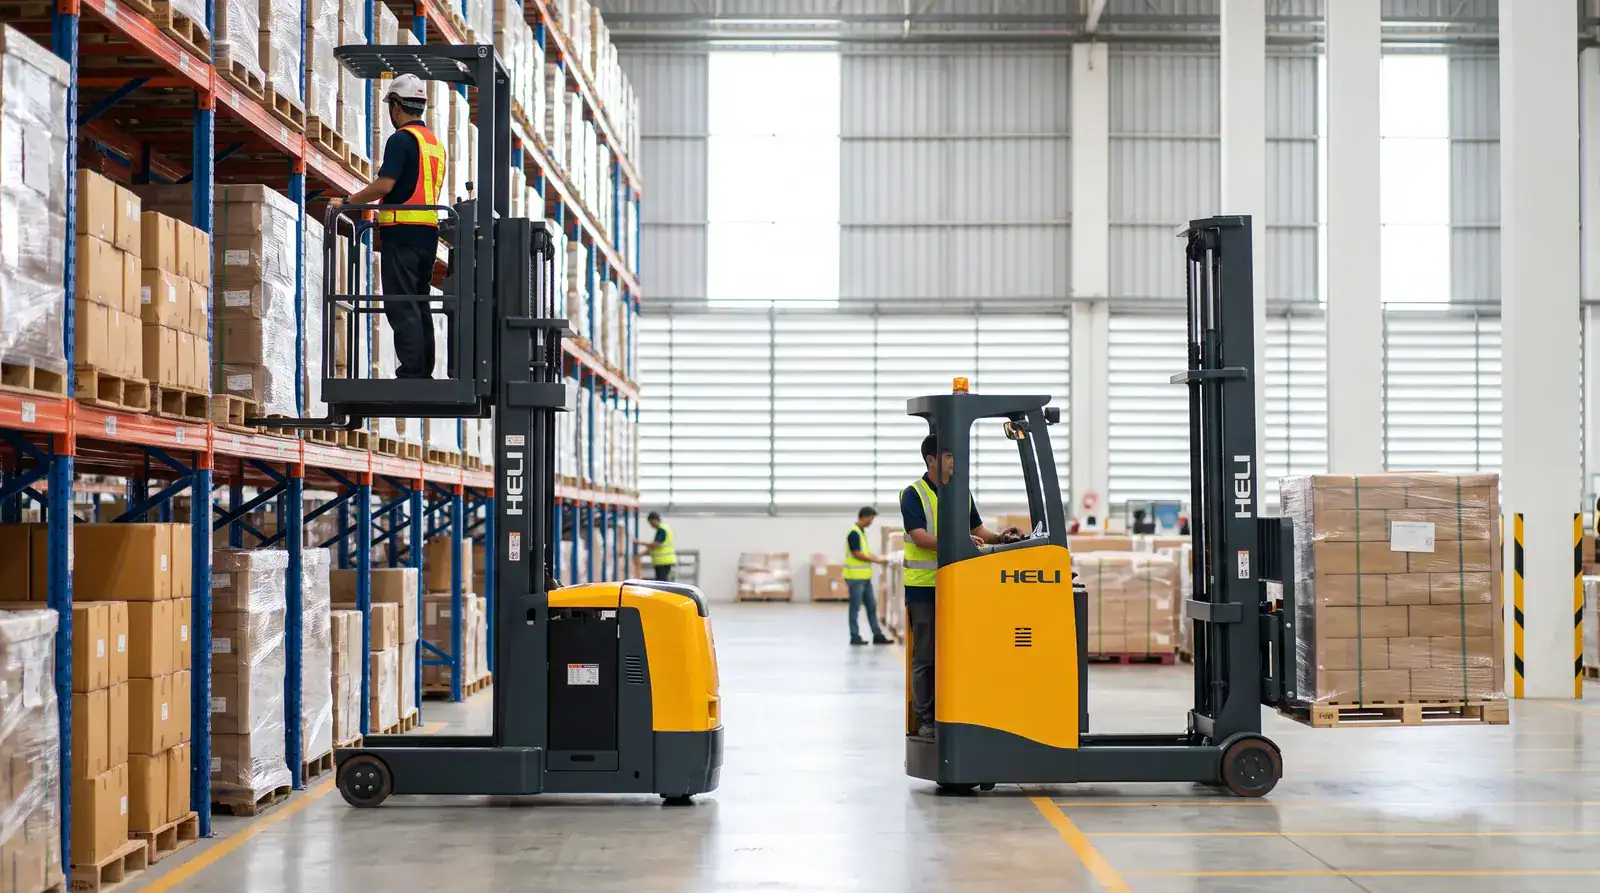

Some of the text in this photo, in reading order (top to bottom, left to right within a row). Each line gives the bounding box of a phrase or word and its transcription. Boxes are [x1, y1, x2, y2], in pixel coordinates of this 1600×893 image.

[506, 451, 523, 515] HELI
[1234, 455, 1252, 518] HELI
[1000, 569, 1061, 584] HELI
